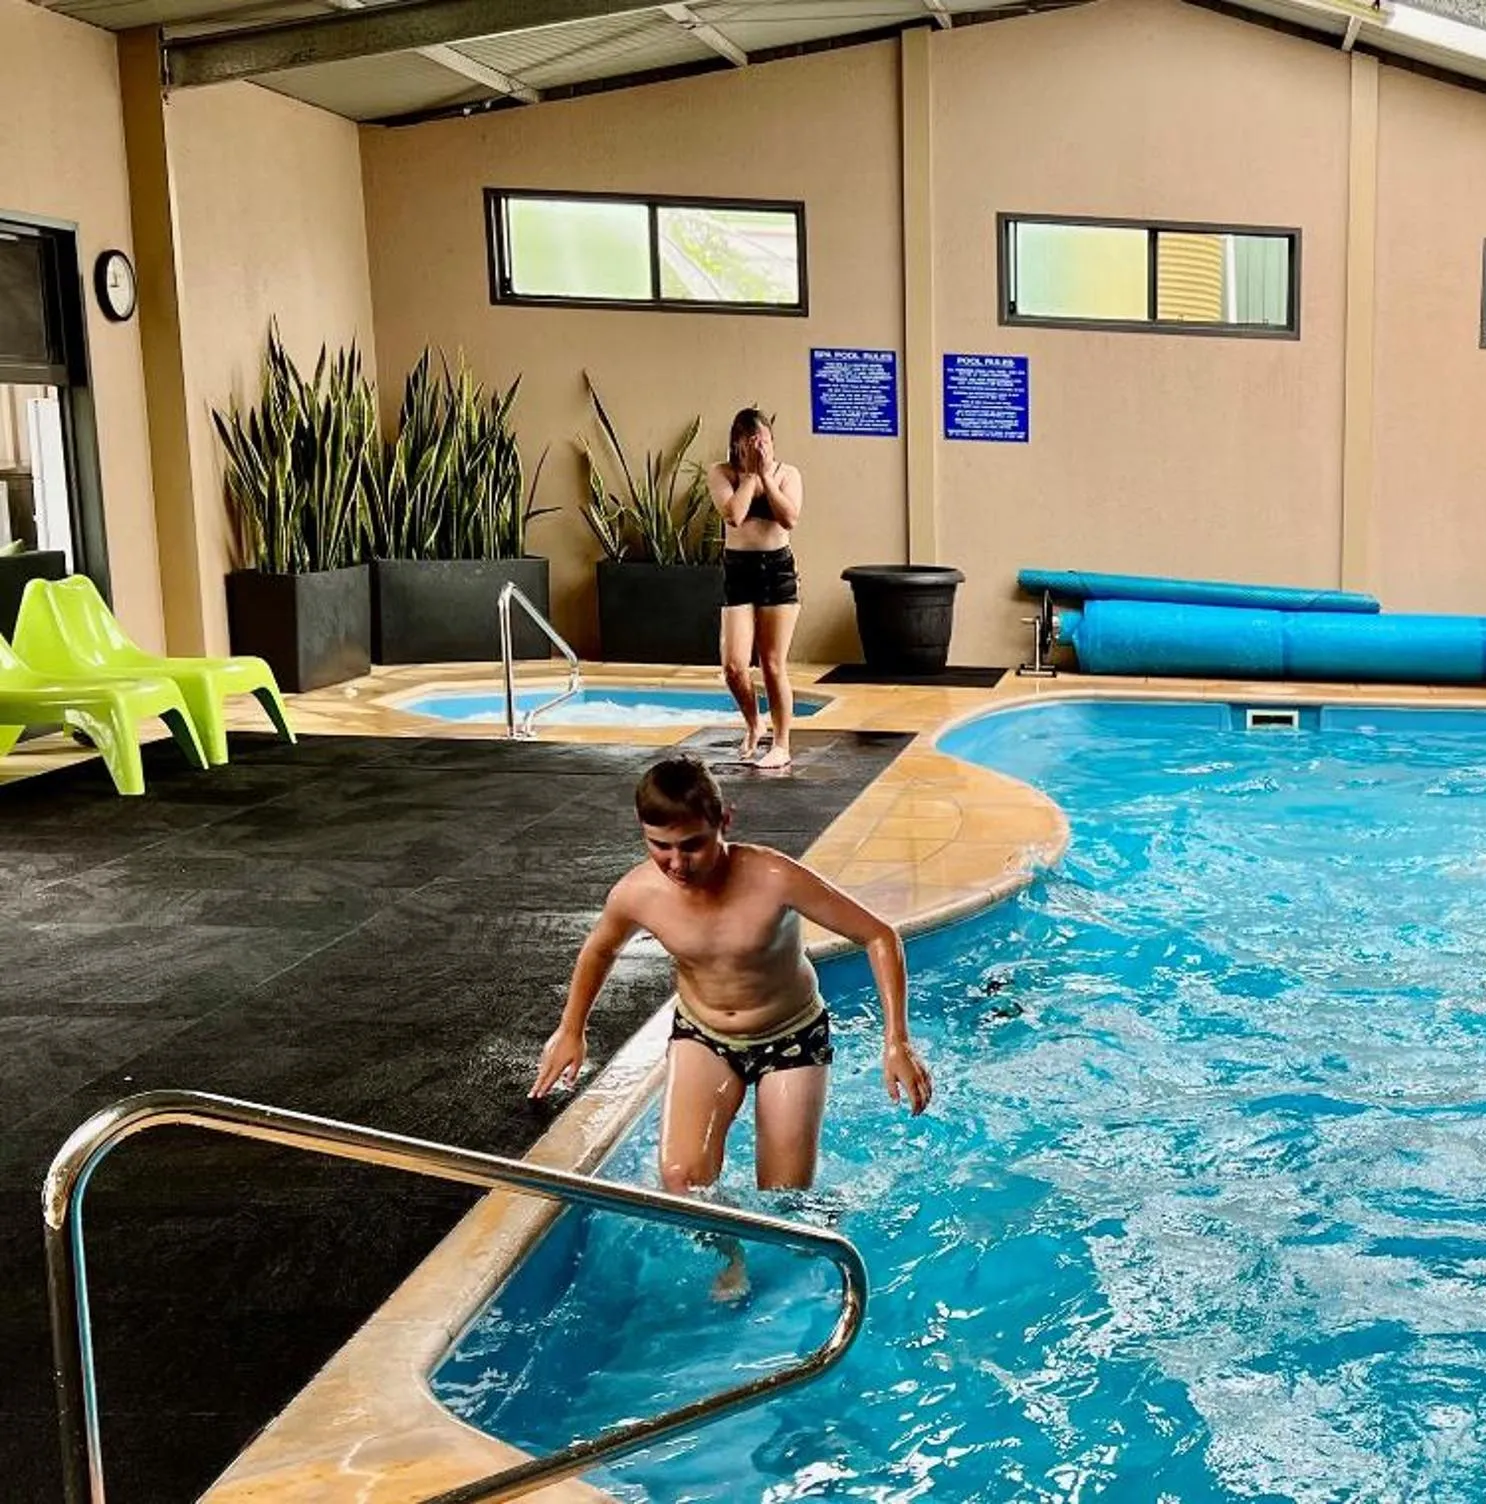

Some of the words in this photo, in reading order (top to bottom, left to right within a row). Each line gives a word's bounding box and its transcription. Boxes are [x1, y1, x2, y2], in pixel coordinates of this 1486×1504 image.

[814, 350, 832, 359] SPA
[834, 352, 860, 360] POOL
[863, 353, 893, 362] RULES
[956, 357, 983, 366] POOL
[984, 358, 1015, 367] RULES
